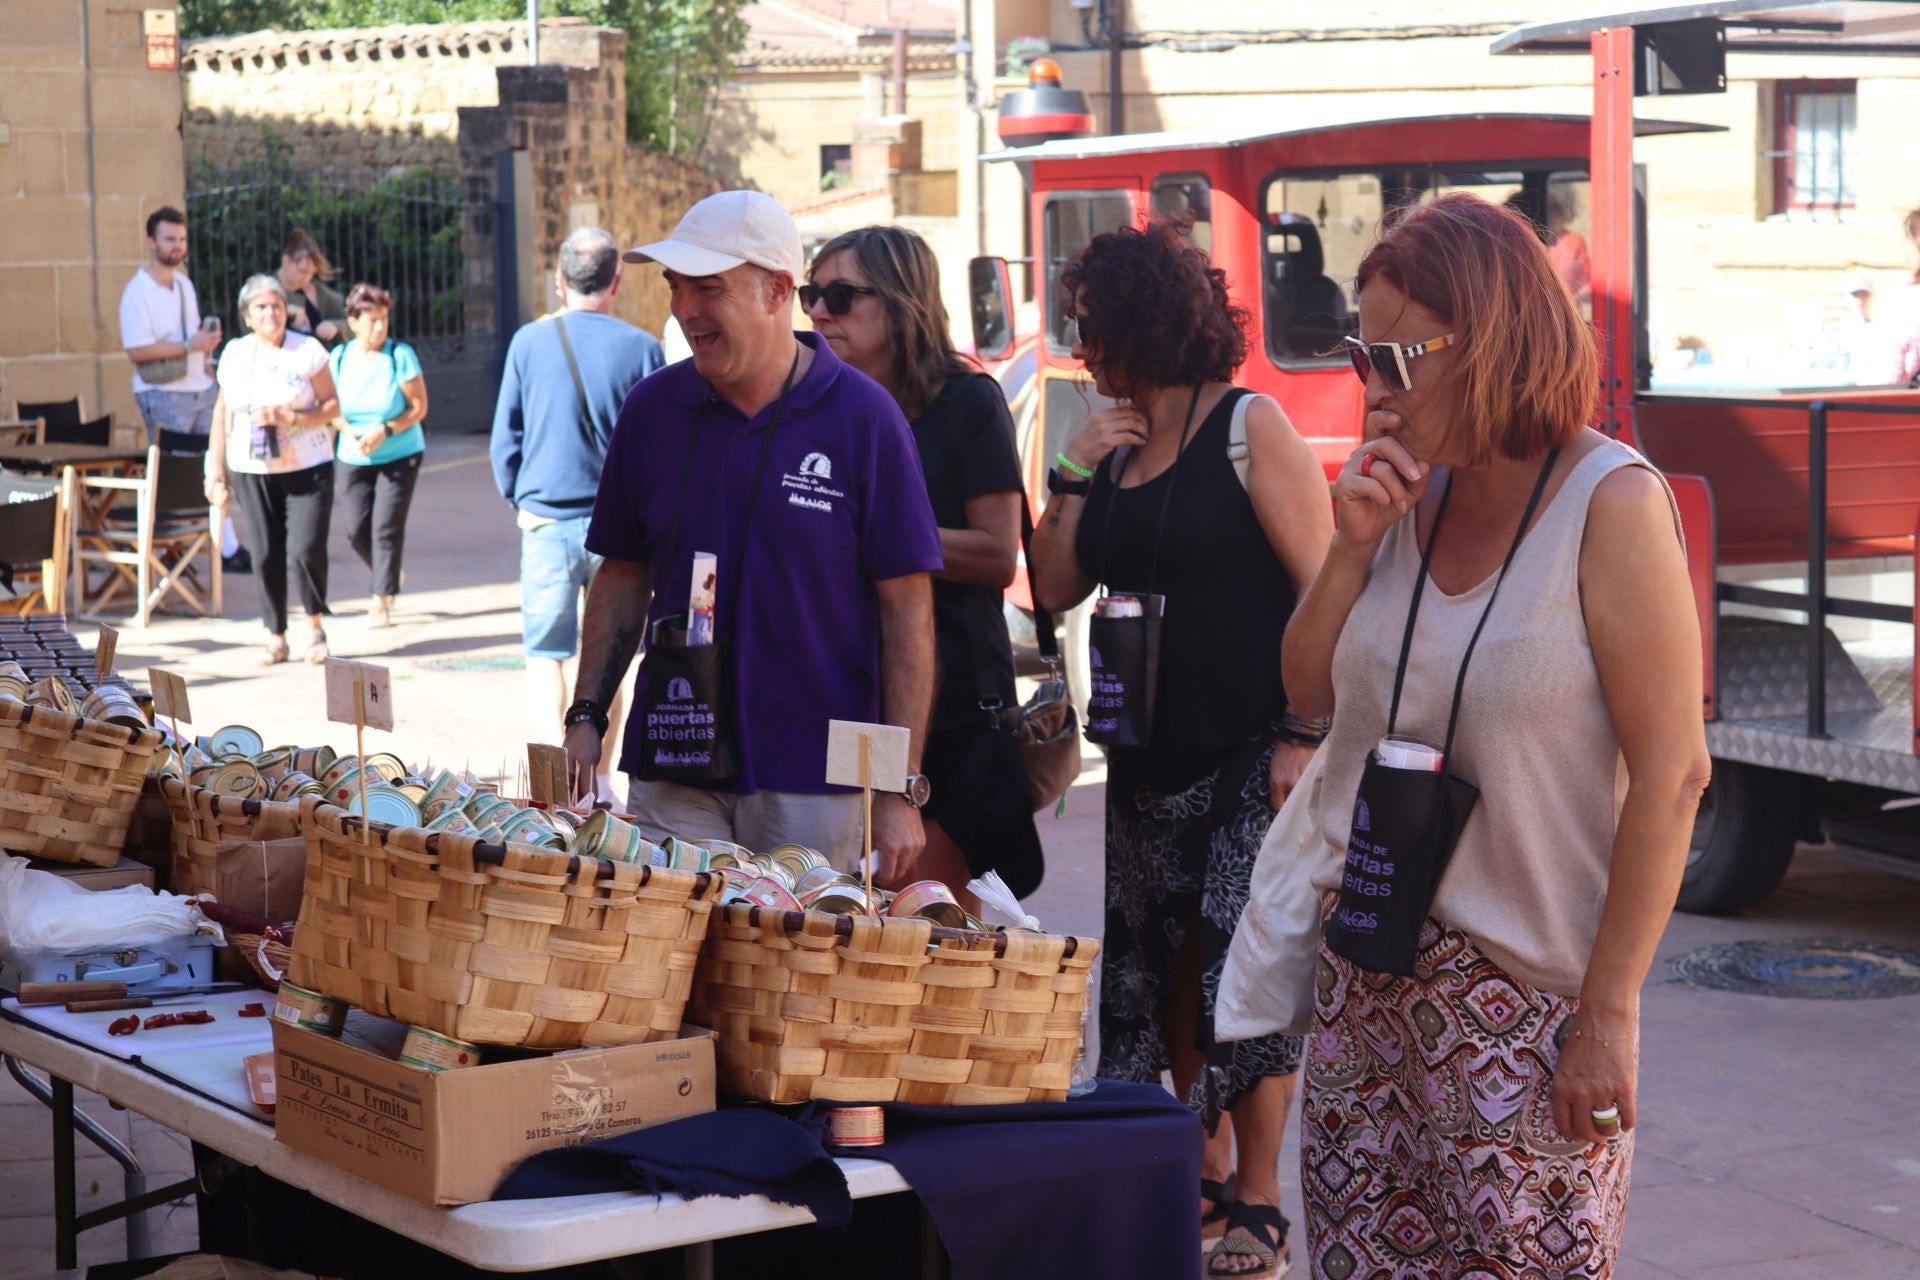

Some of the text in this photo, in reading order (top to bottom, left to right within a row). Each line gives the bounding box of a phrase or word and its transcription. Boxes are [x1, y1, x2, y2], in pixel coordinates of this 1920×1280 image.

[656, 703, 695, 711] JORNADA
[648, 712, 715, 728] puertas
[648, 726, 715, 740] abiertas
[1373, 845, 1389, 856] DE
[291, 1060, 323, 1088] Pates
[335, 1076, 351, 1099] La
[363, 1087, 409, 1122] Ermita
[602, 1102, 614, 1114] 82
[615, 1100, 628, 1112] 57
[525, 1126, 551, 1140] 26125
[595, 1119, 606, 1130] de
[607, 1116, 642, 1130] Cameros
